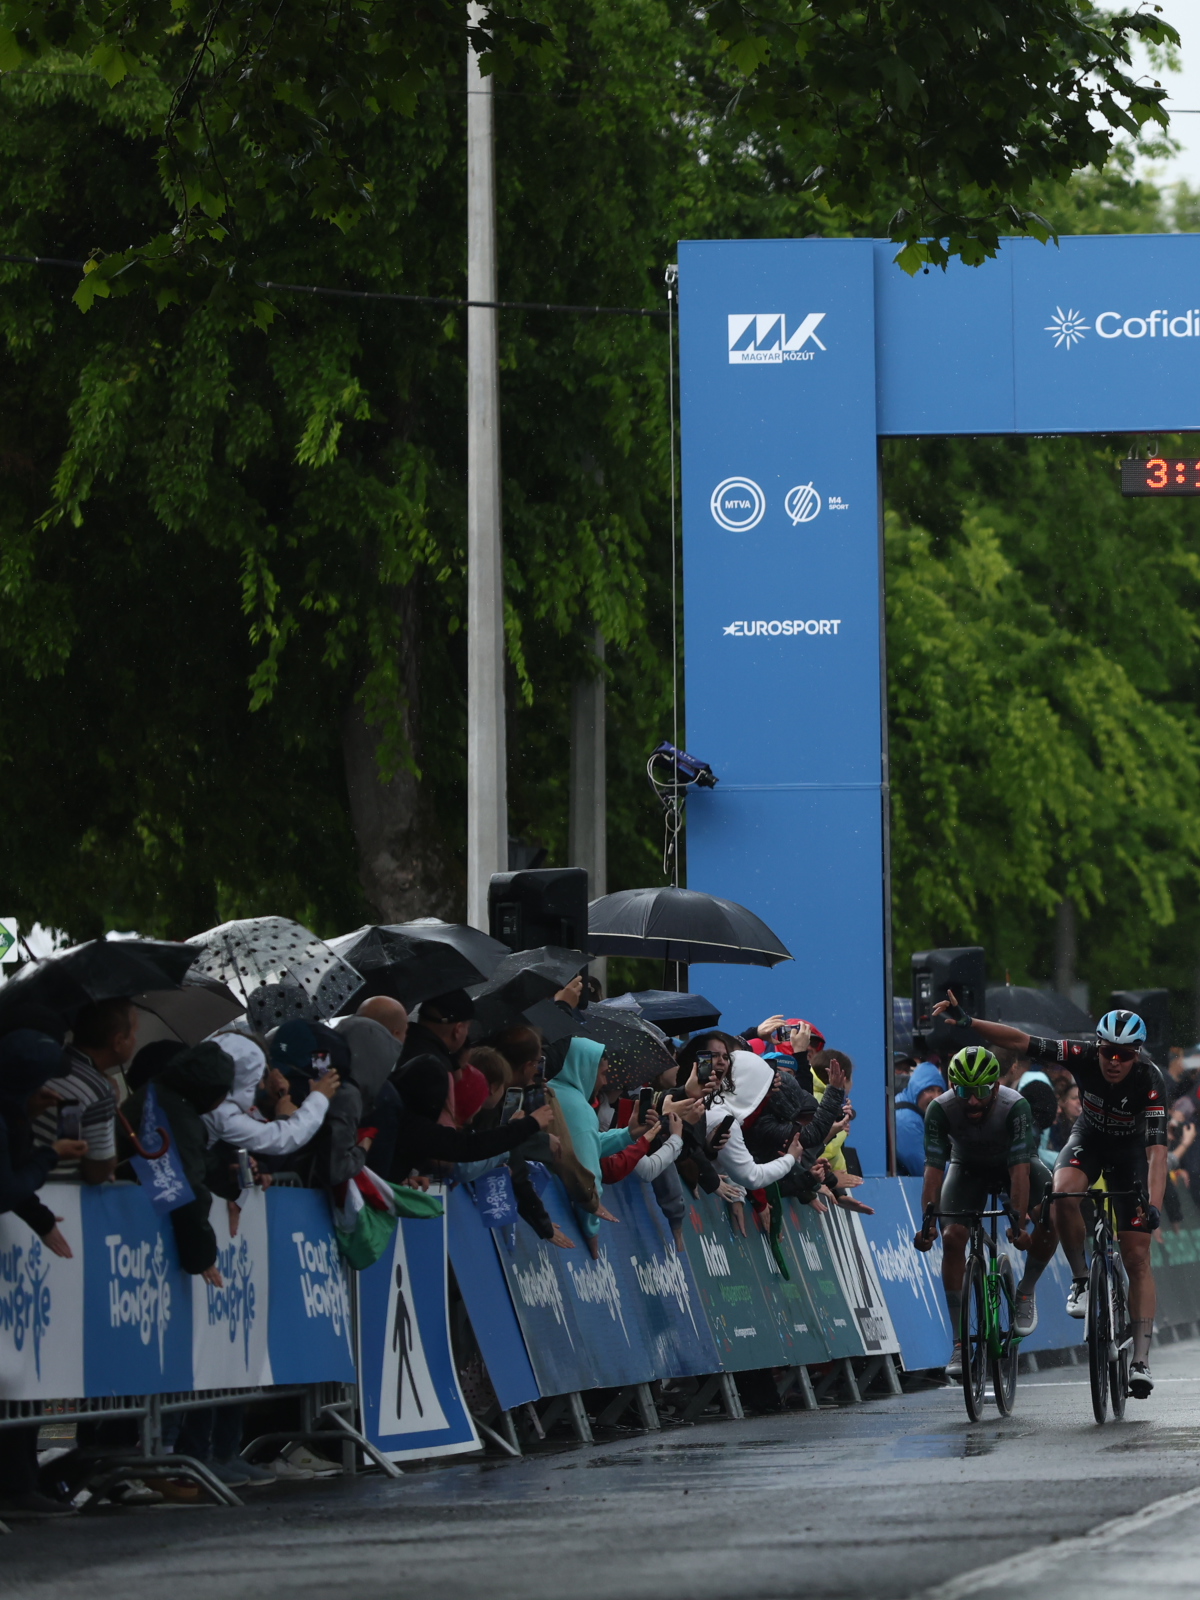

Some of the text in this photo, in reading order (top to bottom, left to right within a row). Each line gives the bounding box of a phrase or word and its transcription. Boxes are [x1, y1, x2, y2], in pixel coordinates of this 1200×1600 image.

[741, 350, 815, 361] MAGYAR KÖZÚT
[725, 500, 752, 509] MTVA
[722, 619, 842, 637] EUROSPORT
[0, 1244, 23, 1283] ur
[105, 1234, 150, 1279] Tour
[291, 1231, 329, 1275] Tour
[0, 1273, 50, 1352] ngrie
[109, 1269, 171, 1346] Hongrie
